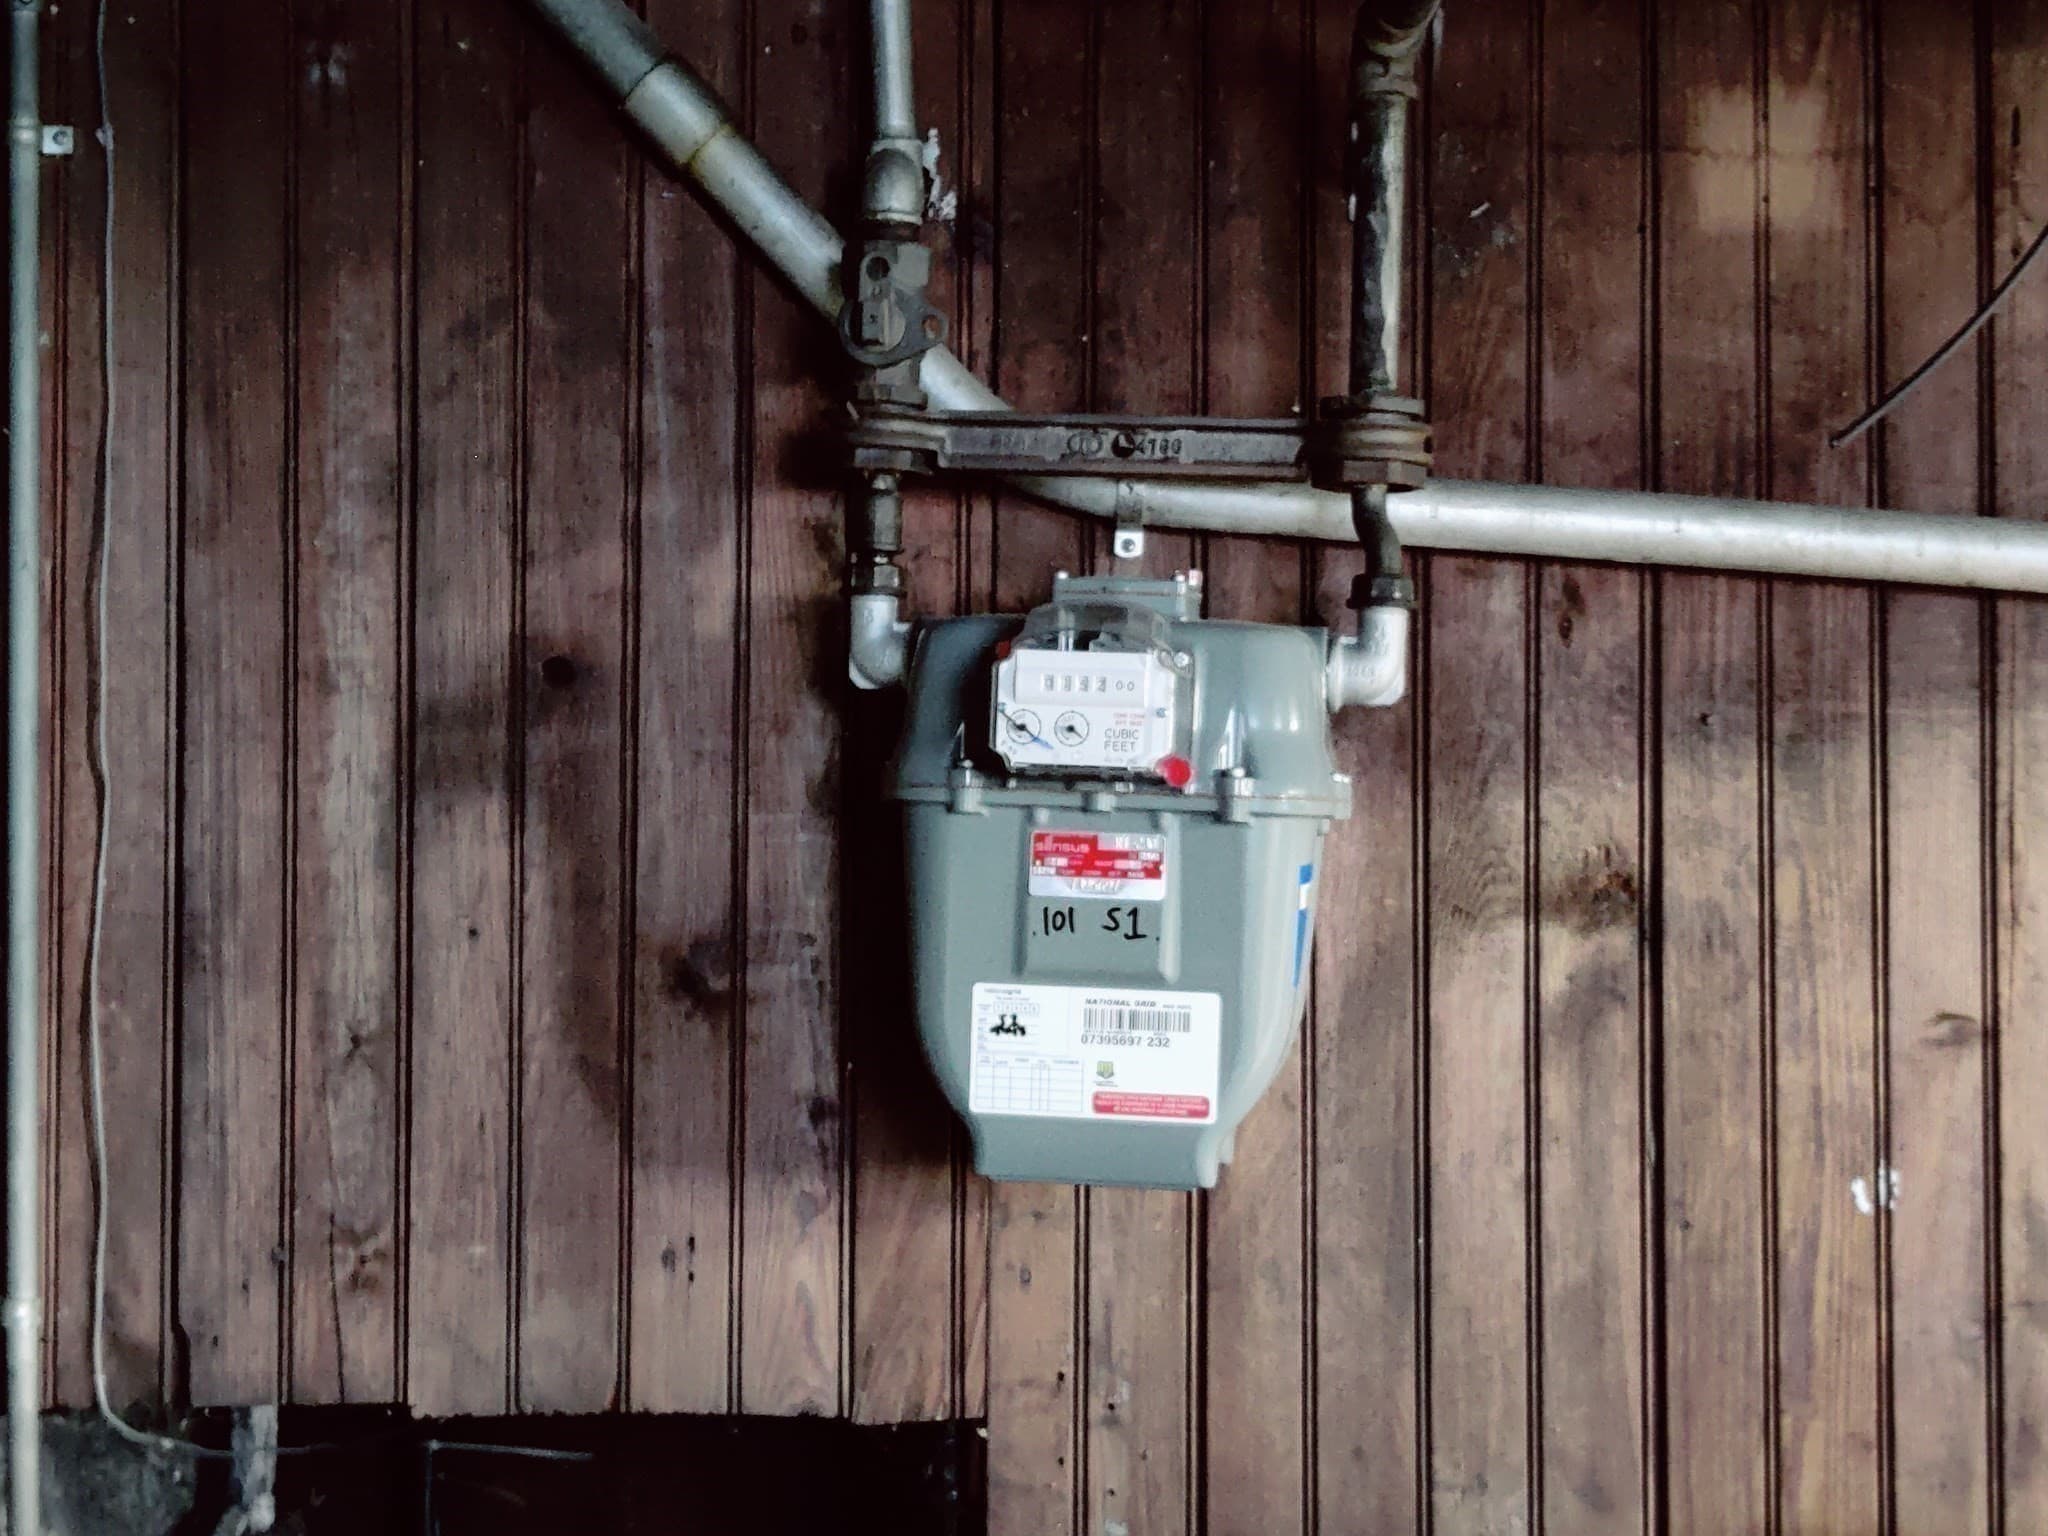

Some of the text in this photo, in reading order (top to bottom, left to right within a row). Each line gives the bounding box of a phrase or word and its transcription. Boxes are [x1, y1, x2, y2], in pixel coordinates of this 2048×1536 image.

[1104, 728, 1139, 741] CUBIC
[1104, 740, 1136, 753] FEET
[1085, 998, 1131, 1007] NATIONAL
[1146, 1036, 1171, 1048] 232
